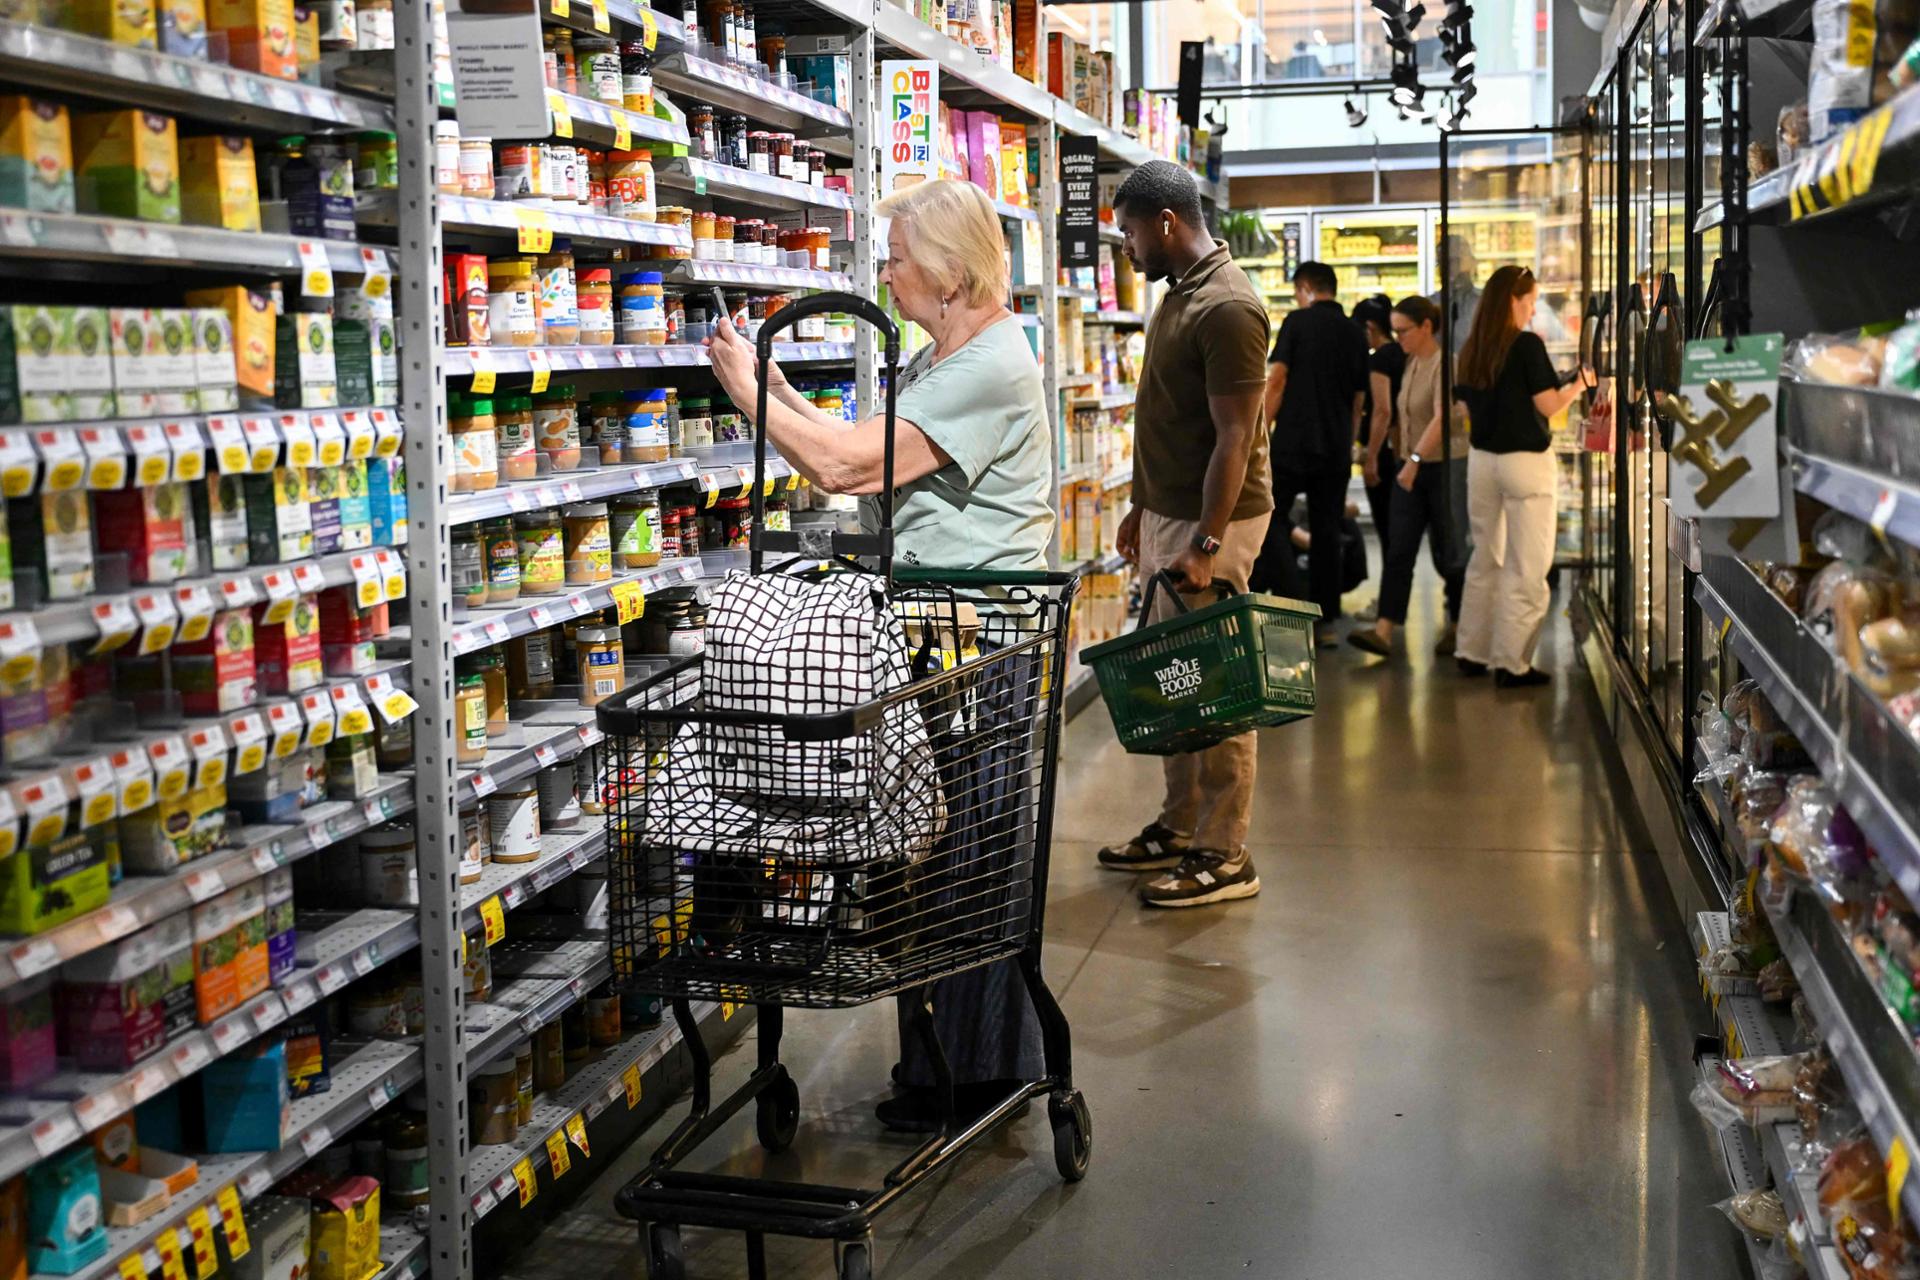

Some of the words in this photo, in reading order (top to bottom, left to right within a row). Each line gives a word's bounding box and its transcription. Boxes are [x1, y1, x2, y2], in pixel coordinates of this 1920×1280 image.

[1186, 46, 1197, 60] 4
[911, 70, 930, 143] BEST
[893, 70, 912, 163] CLASS
[914, 144, 930, 161] IN
[1063, 154, 1096, 165] ORGANIC
[1065, 165, 1093, 174] OPTIONS
[1067, 182, 1091, 191] EVERY
[1069, 191, 1090, 200] AISLE
[1154, 658, 1200, 682] WHOLE
[1160, 671, 1202, 696] FOODS
[1168, 687, 1198, 701] MARKET
[1195, 870, 1216, 886] N
